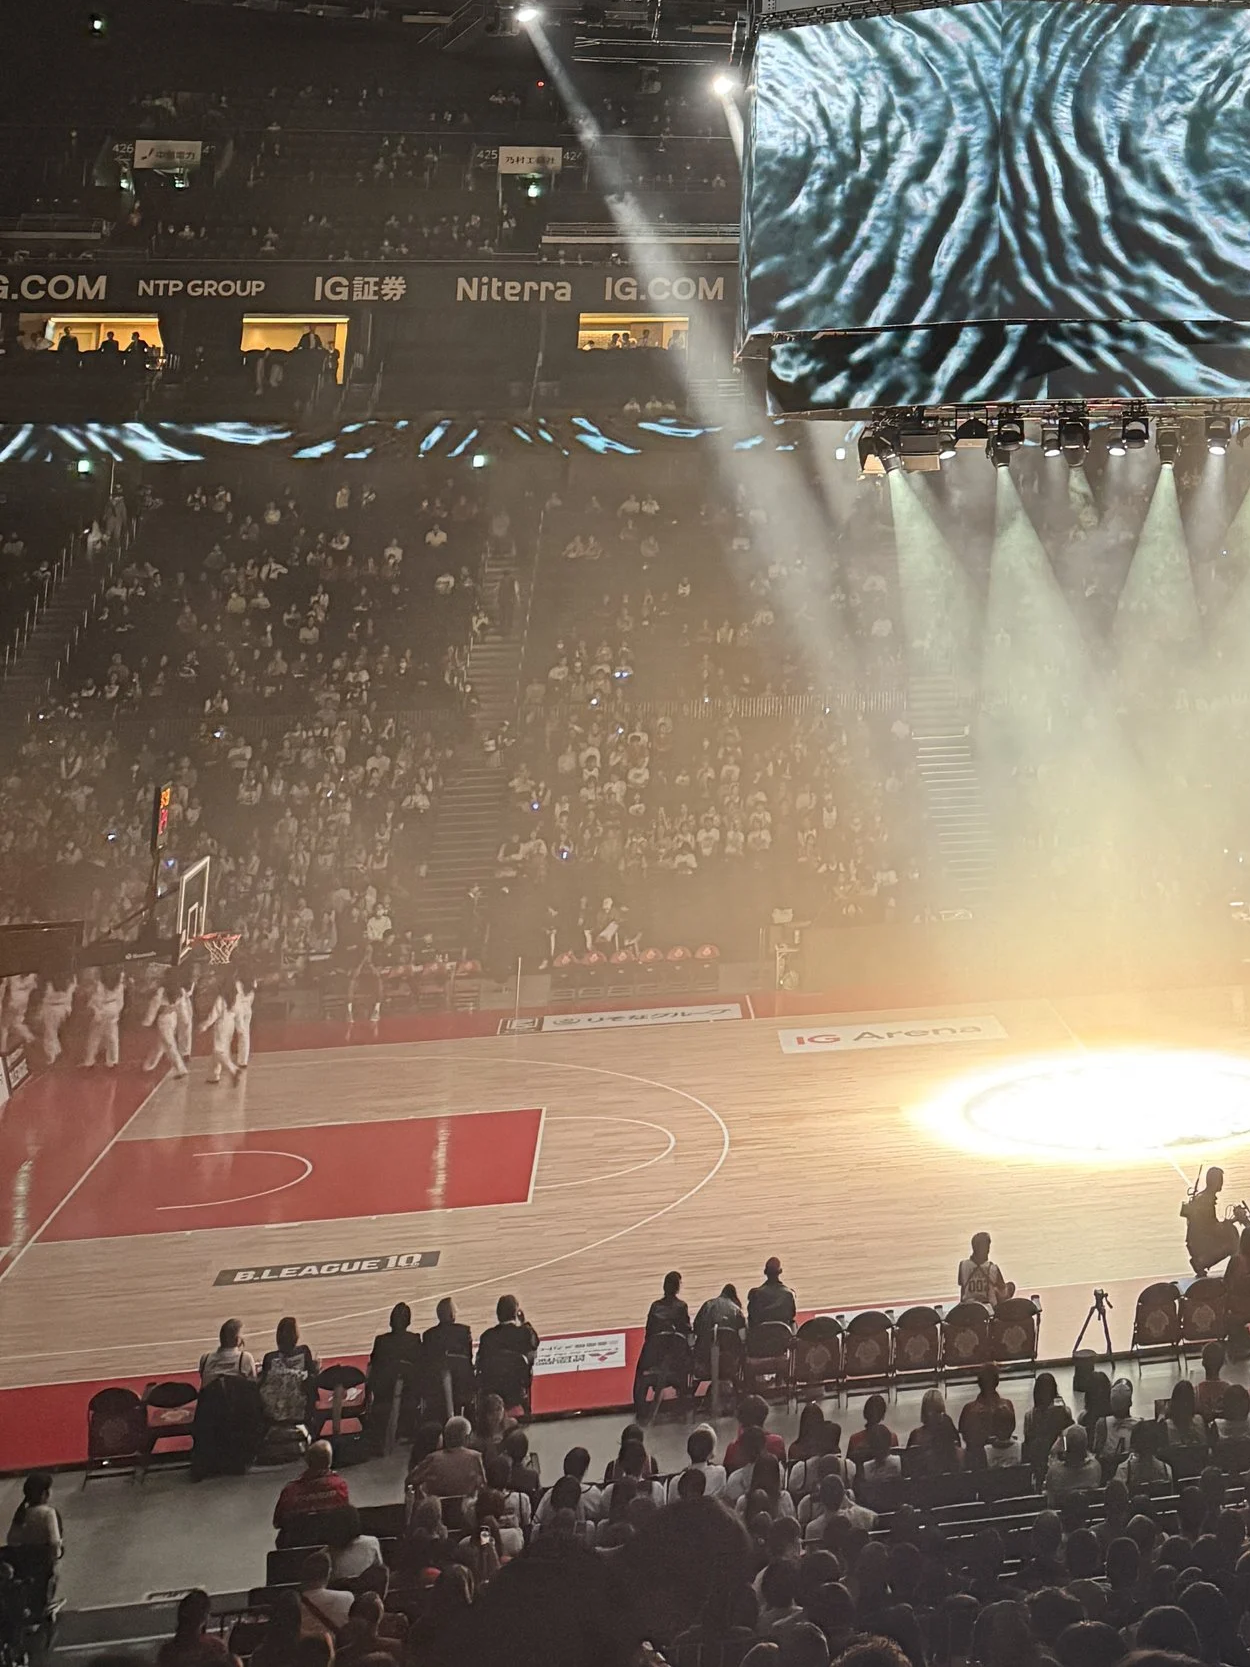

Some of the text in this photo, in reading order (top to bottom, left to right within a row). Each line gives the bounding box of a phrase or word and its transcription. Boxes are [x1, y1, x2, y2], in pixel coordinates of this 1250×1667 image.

[112, 143, 134, 154] 426
[477, 149, 498, 160] 425
[137, 279, 266, 297] NTP GROUP
[314, 275, 407, 302] IG証券
[456, 276, 572, 302] Niterra
[604, 276, 724, 301] IG.COM
[796, 1024, 982, 1046] IG Arena
[233, 1258, 381, 1283] B.LEAGUE
